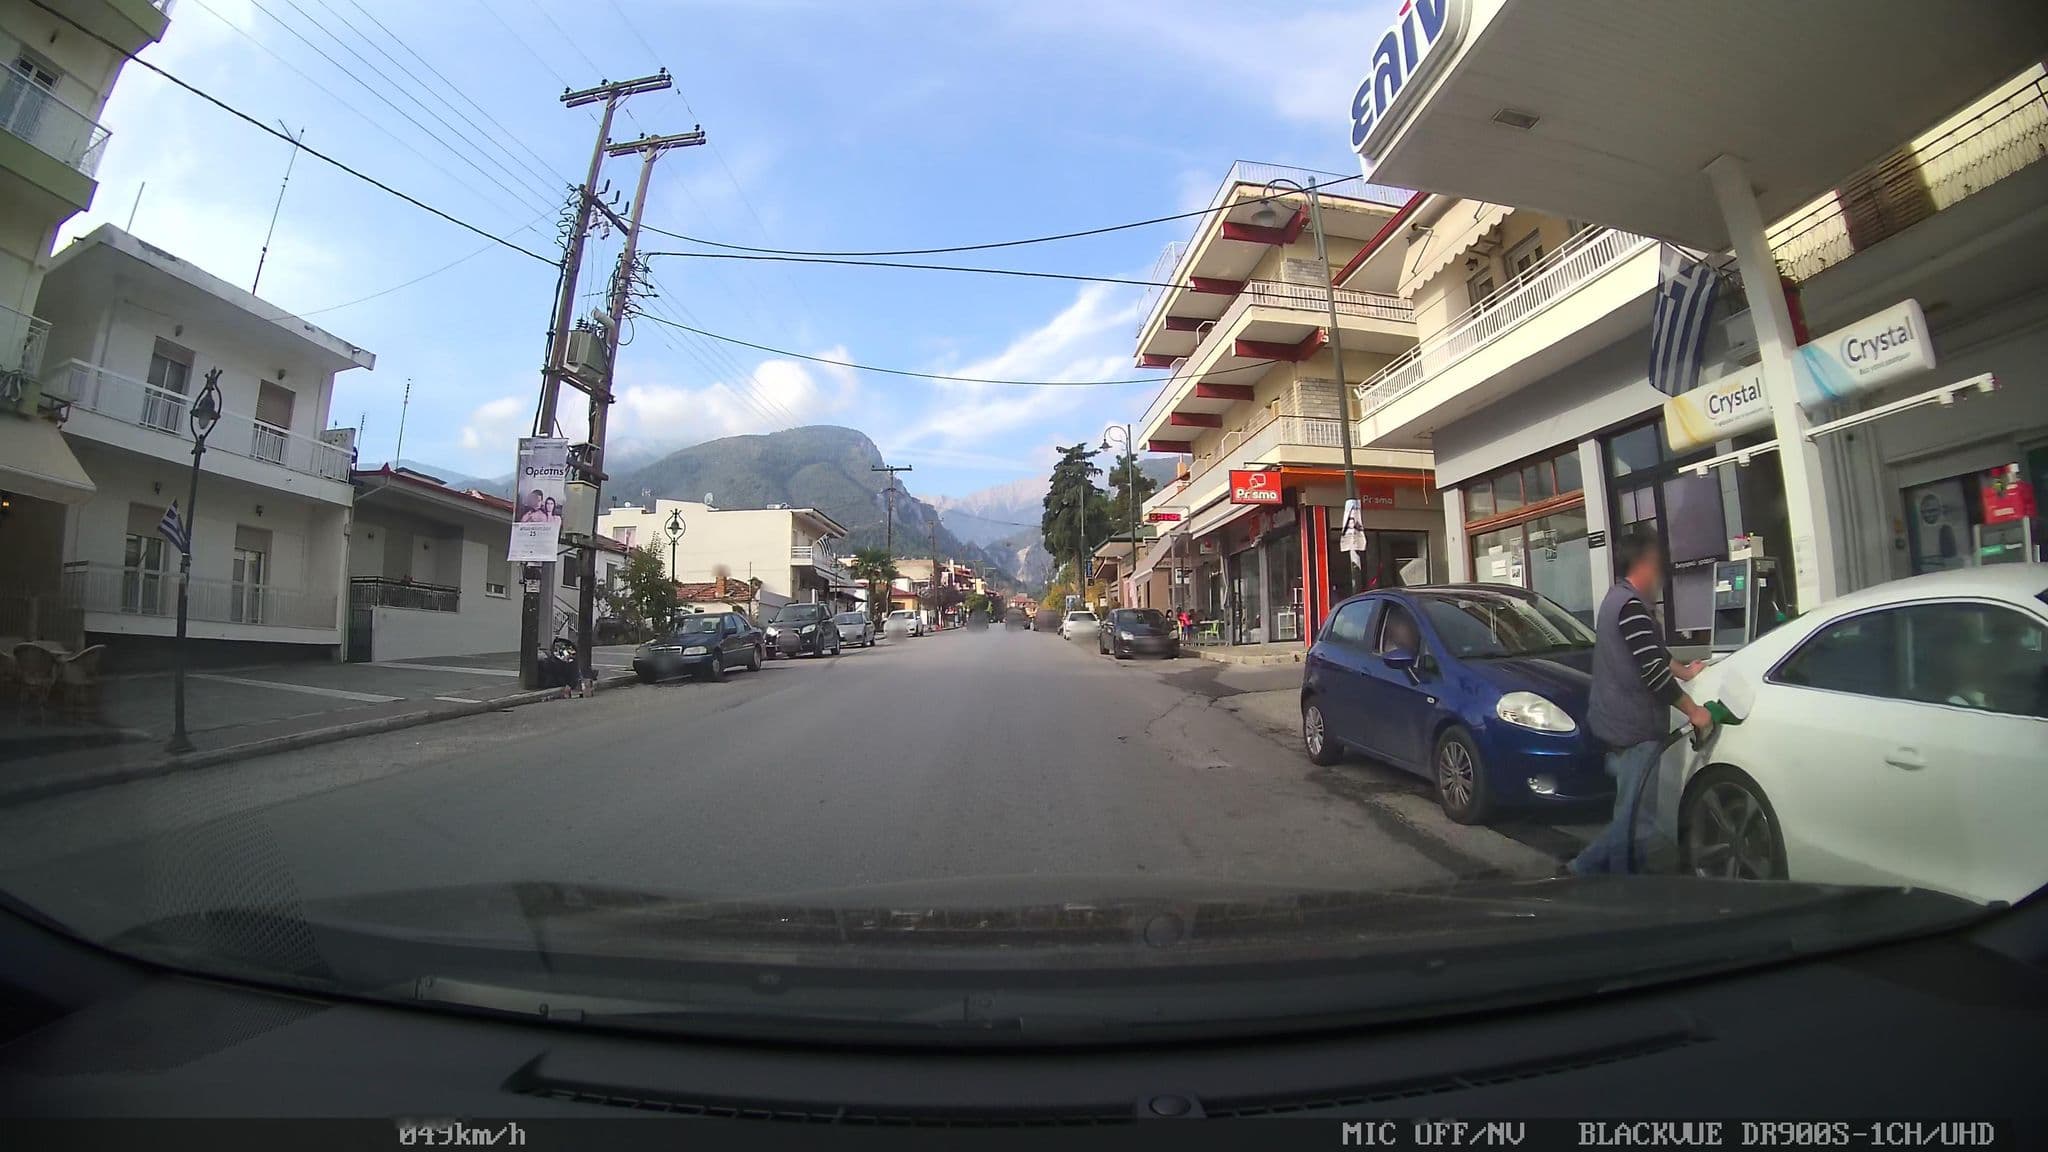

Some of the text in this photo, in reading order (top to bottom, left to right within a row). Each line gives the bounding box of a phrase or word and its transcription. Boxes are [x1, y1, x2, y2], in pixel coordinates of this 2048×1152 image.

[1847, 316, 1914, 362] Crystal
[1709, 377, 1762, 414] Crystal
[525, 466, 564, 478] Ορέστης
